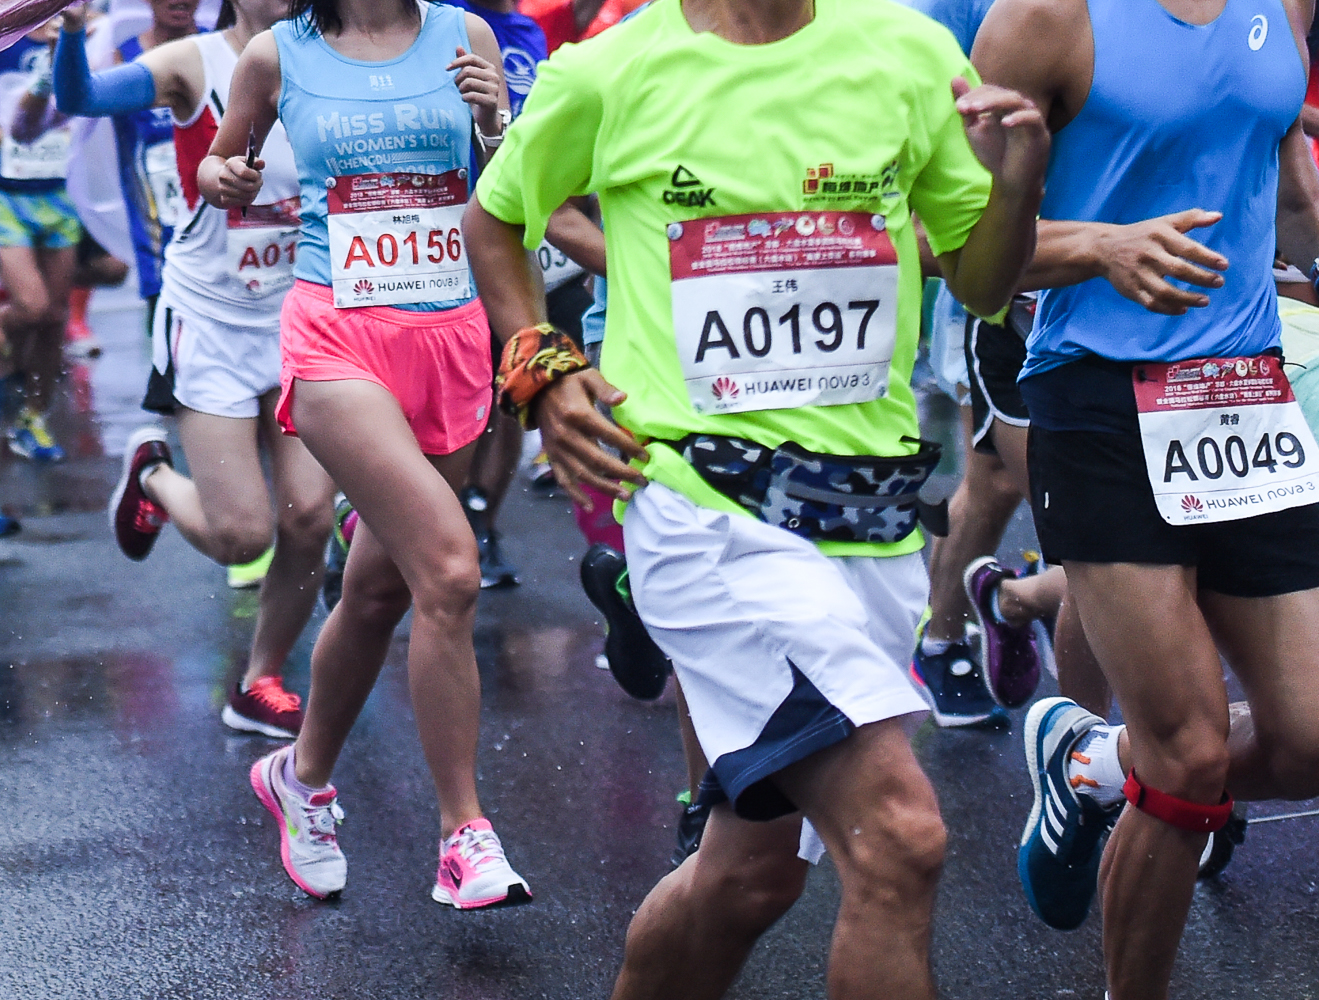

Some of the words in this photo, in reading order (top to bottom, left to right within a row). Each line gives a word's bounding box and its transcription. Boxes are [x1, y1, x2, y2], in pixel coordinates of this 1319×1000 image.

[335, 134, 417, 156] WOMEN'S
[420, 133, 449, 148] 10K
[340, 154, 392, 170] CHENGDU
[343, 227, 462, 270] A0156
[377, 280, 426, 292] HUAWEI
[429, 277, 453, 288] nova
[453, 277, 459, 286] 3
[771, 279, 799, 294] 王伟
[693, 299, 881, 364] A0197
[744, 378, 813, 395] HUAWEI
[818, 375, 859, 390] nova
[861, 373, 870, 386] 3
[1163, 431, 1306, 483] A0049
[1205, 494, 1264, 510] HUAWEI
[1267, 483, 1305, 501] nova
[1307, 481, 1316, 491] 3
